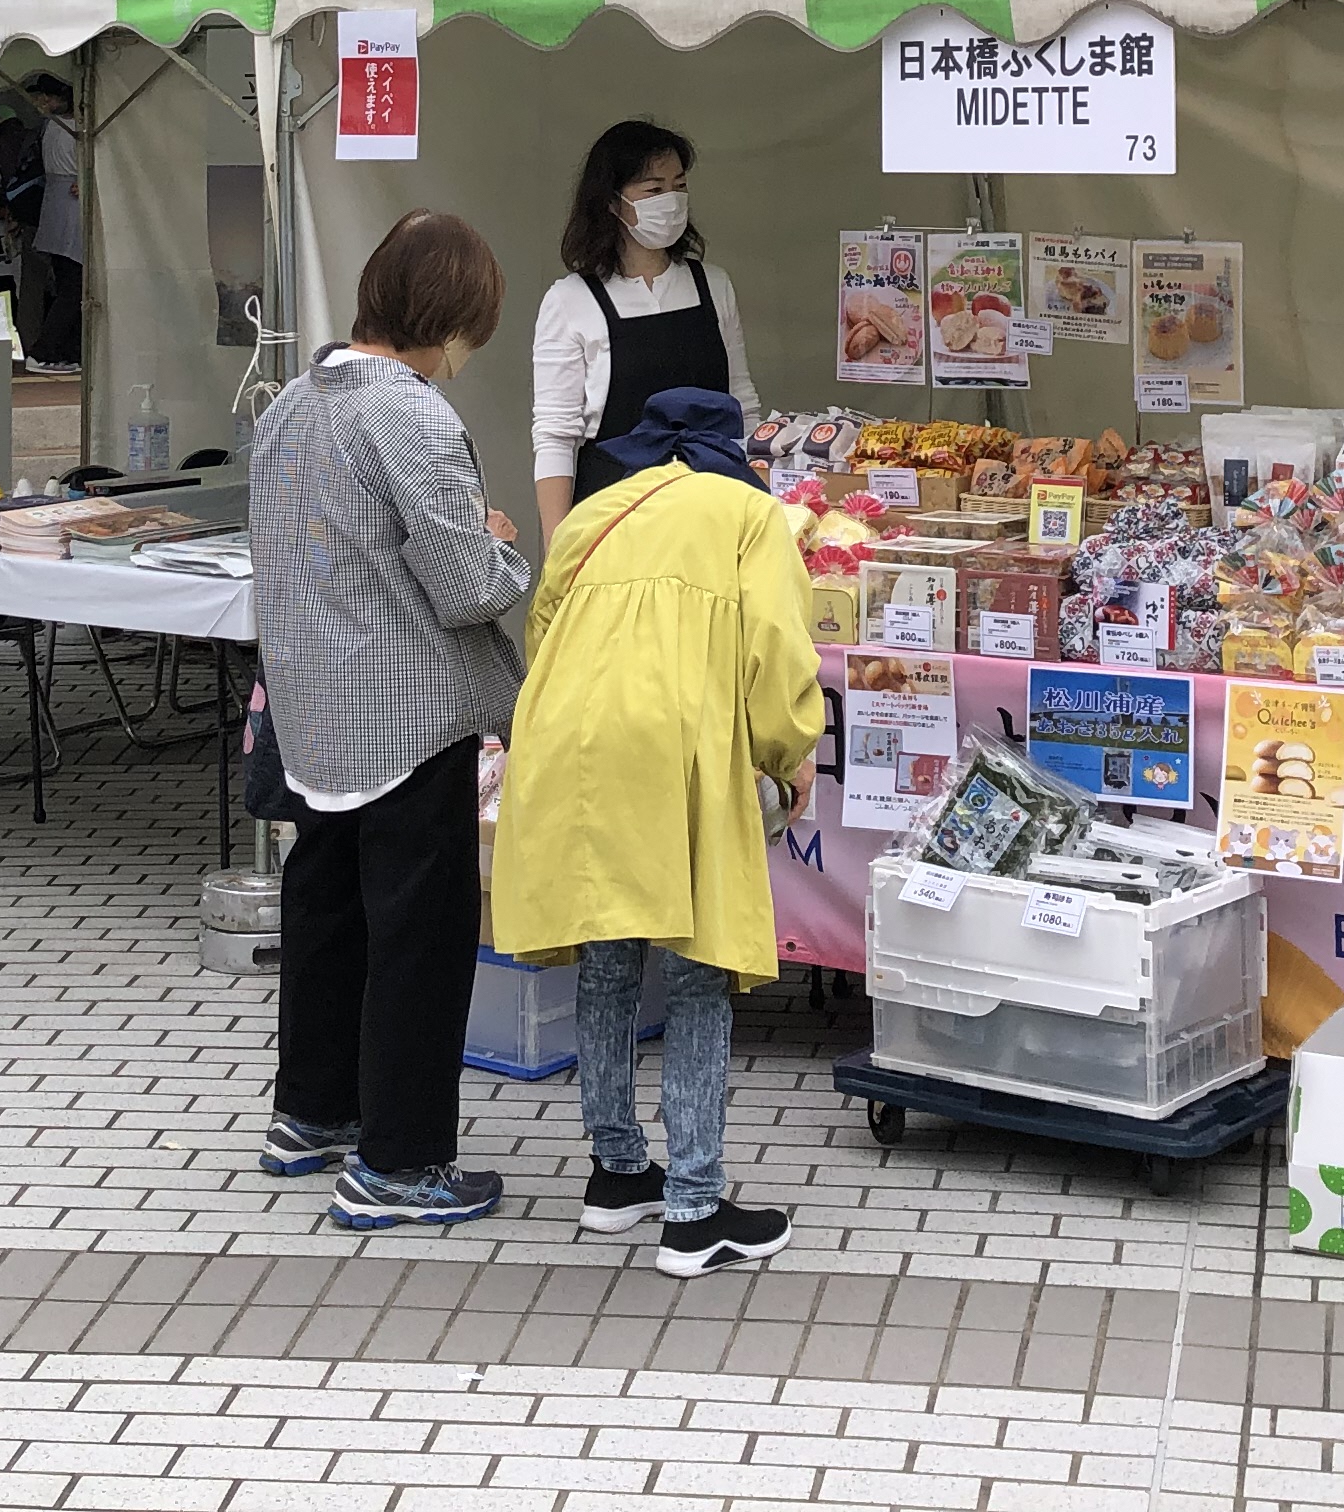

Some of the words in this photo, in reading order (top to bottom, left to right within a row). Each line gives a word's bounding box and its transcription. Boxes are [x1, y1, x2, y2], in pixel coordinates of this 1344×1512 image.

[370, 42, 401, 54] PayPay
[899, 32, 1155, 81] 日本橋ふくしま館
[364, 62, 379, 130] 使えます。
[381, 61, 395, 123] ペイペイ
[956, 85, 1090, 126] MIDETTE
[1125, 134, 1157, 161] 73
[1044, 244, 1118, 263] 相馬もちパイ
[1043, 687, 1166, 717] 松川浦産
[1032, 912, 1062, 926] ¥1080
